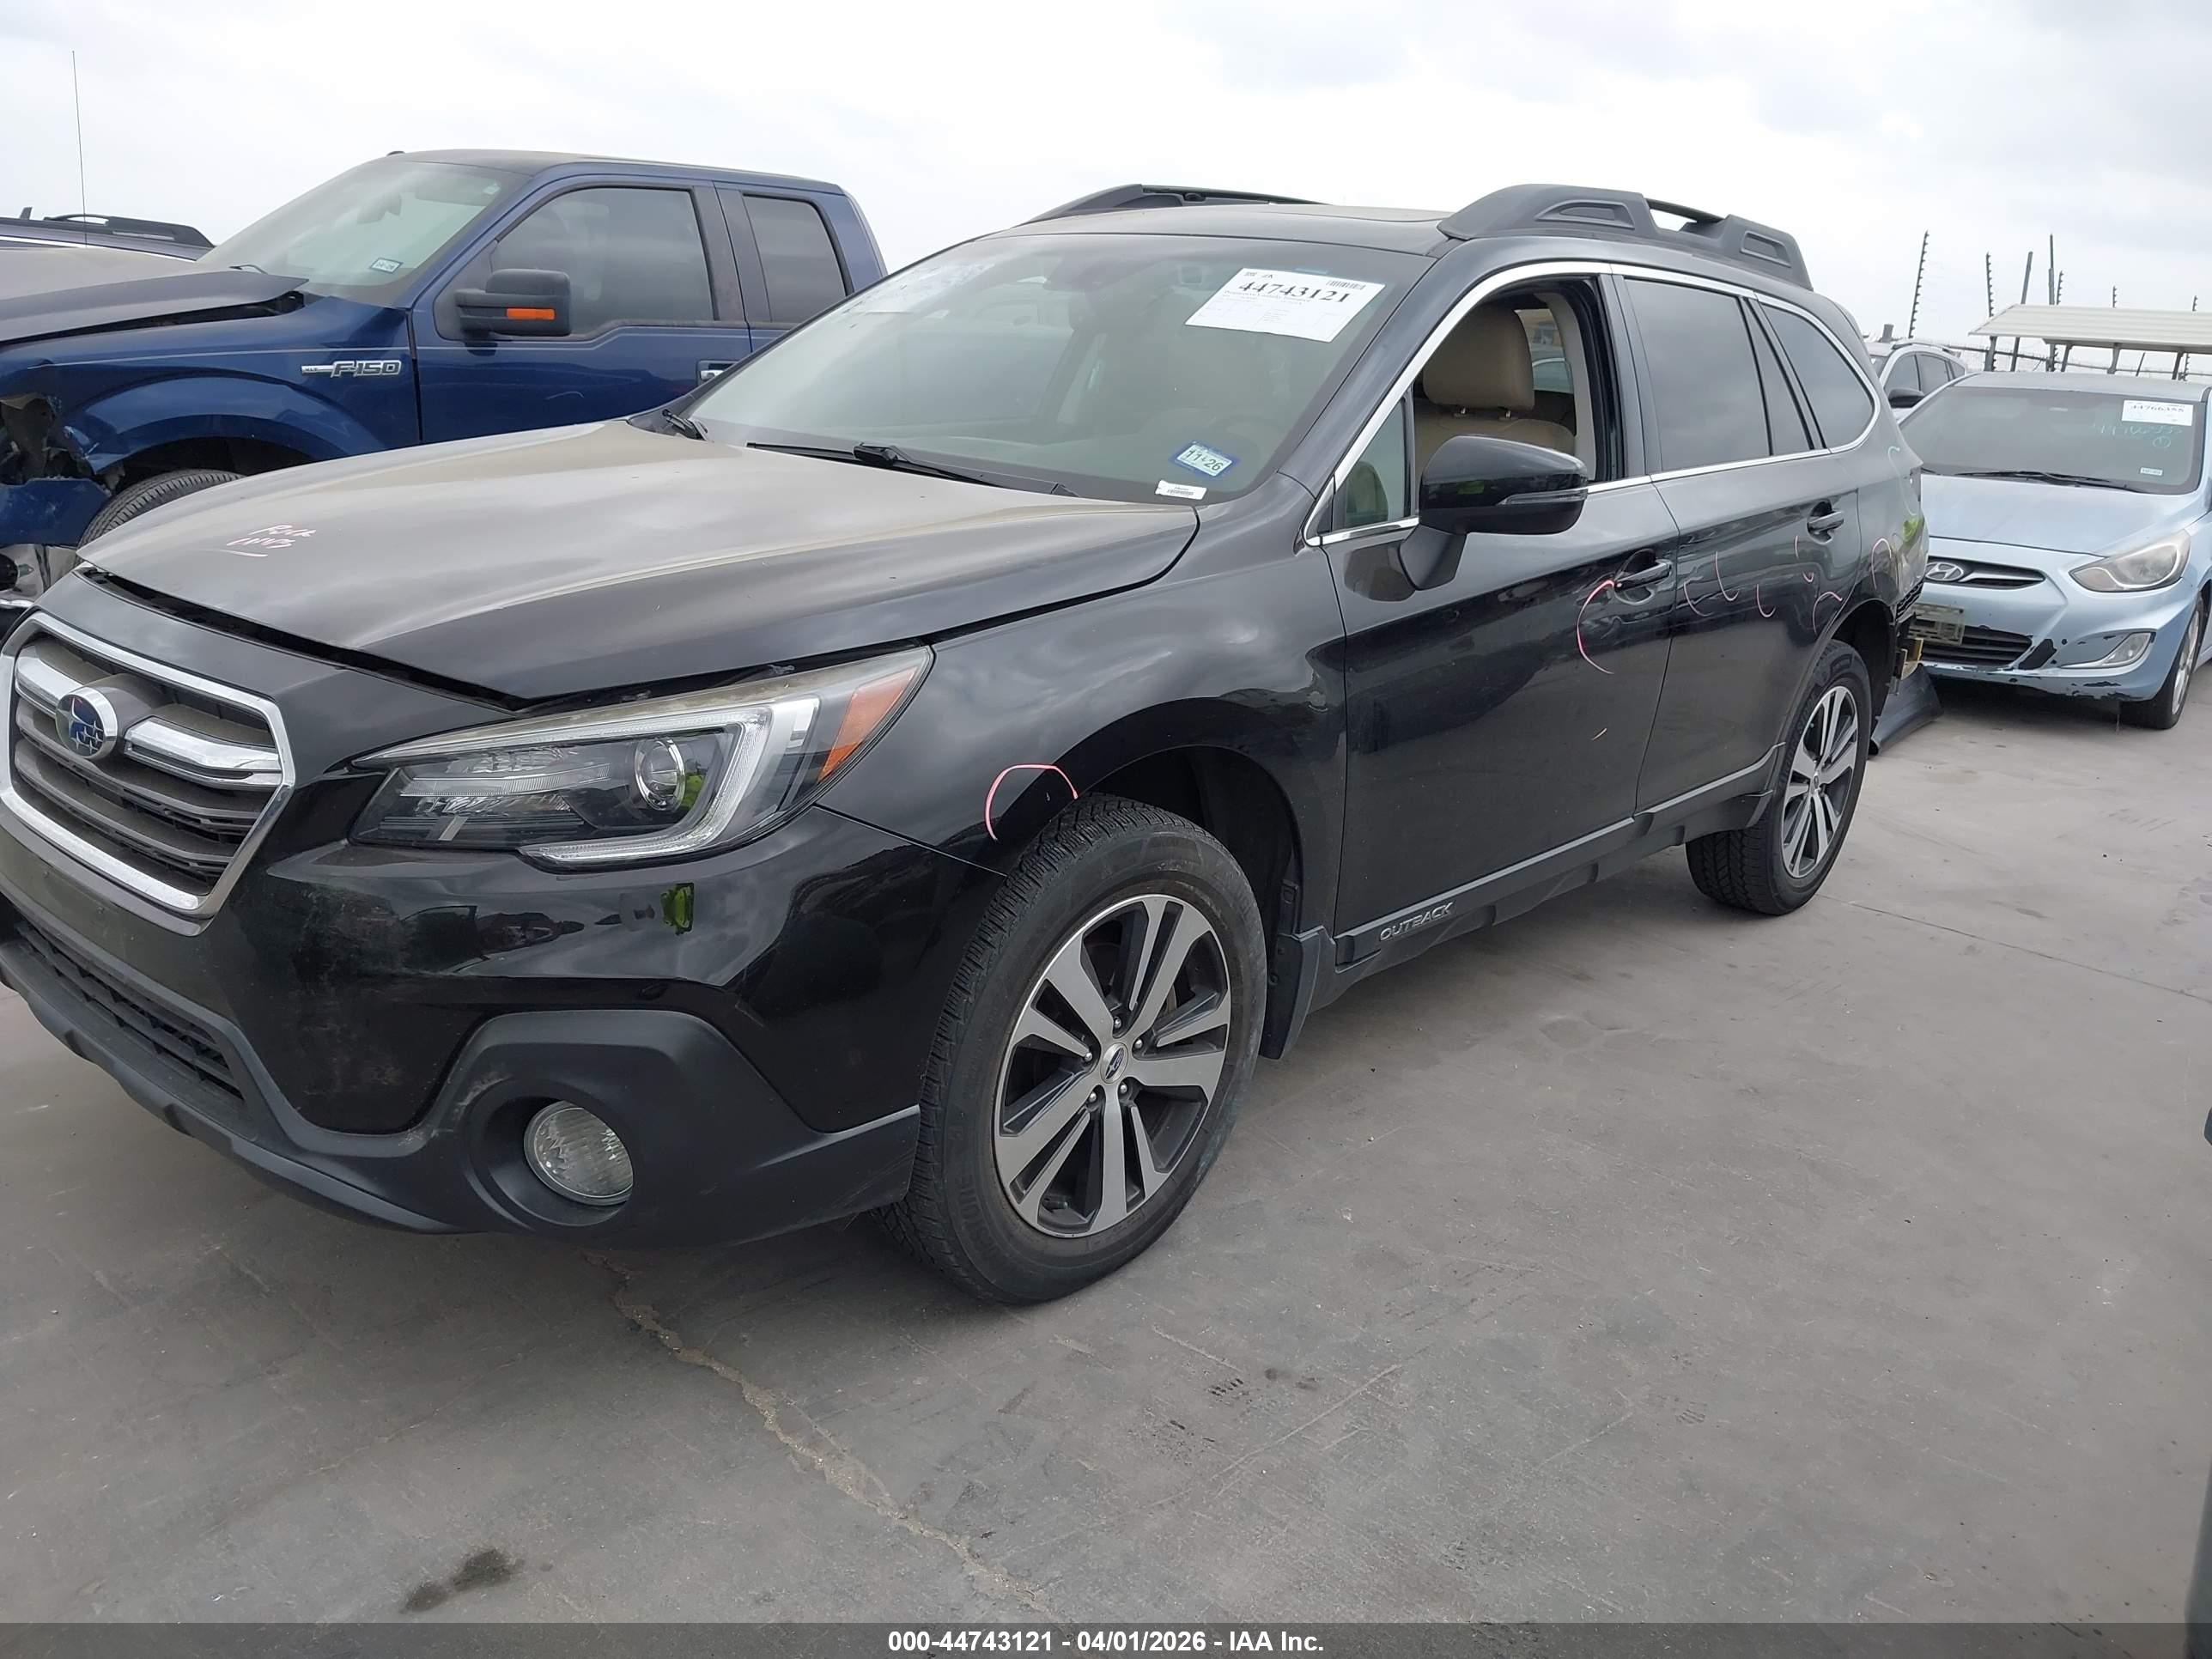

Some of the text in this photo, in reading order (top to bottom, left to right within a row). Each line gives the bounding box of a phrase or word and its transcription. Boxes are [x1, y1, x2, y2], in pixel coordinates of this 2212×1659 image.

[1238, 281, 1351, 303] 44743121
[331, 360, 402, 378] F-150
[1379, 902, 1454, 941] OUTBACK
